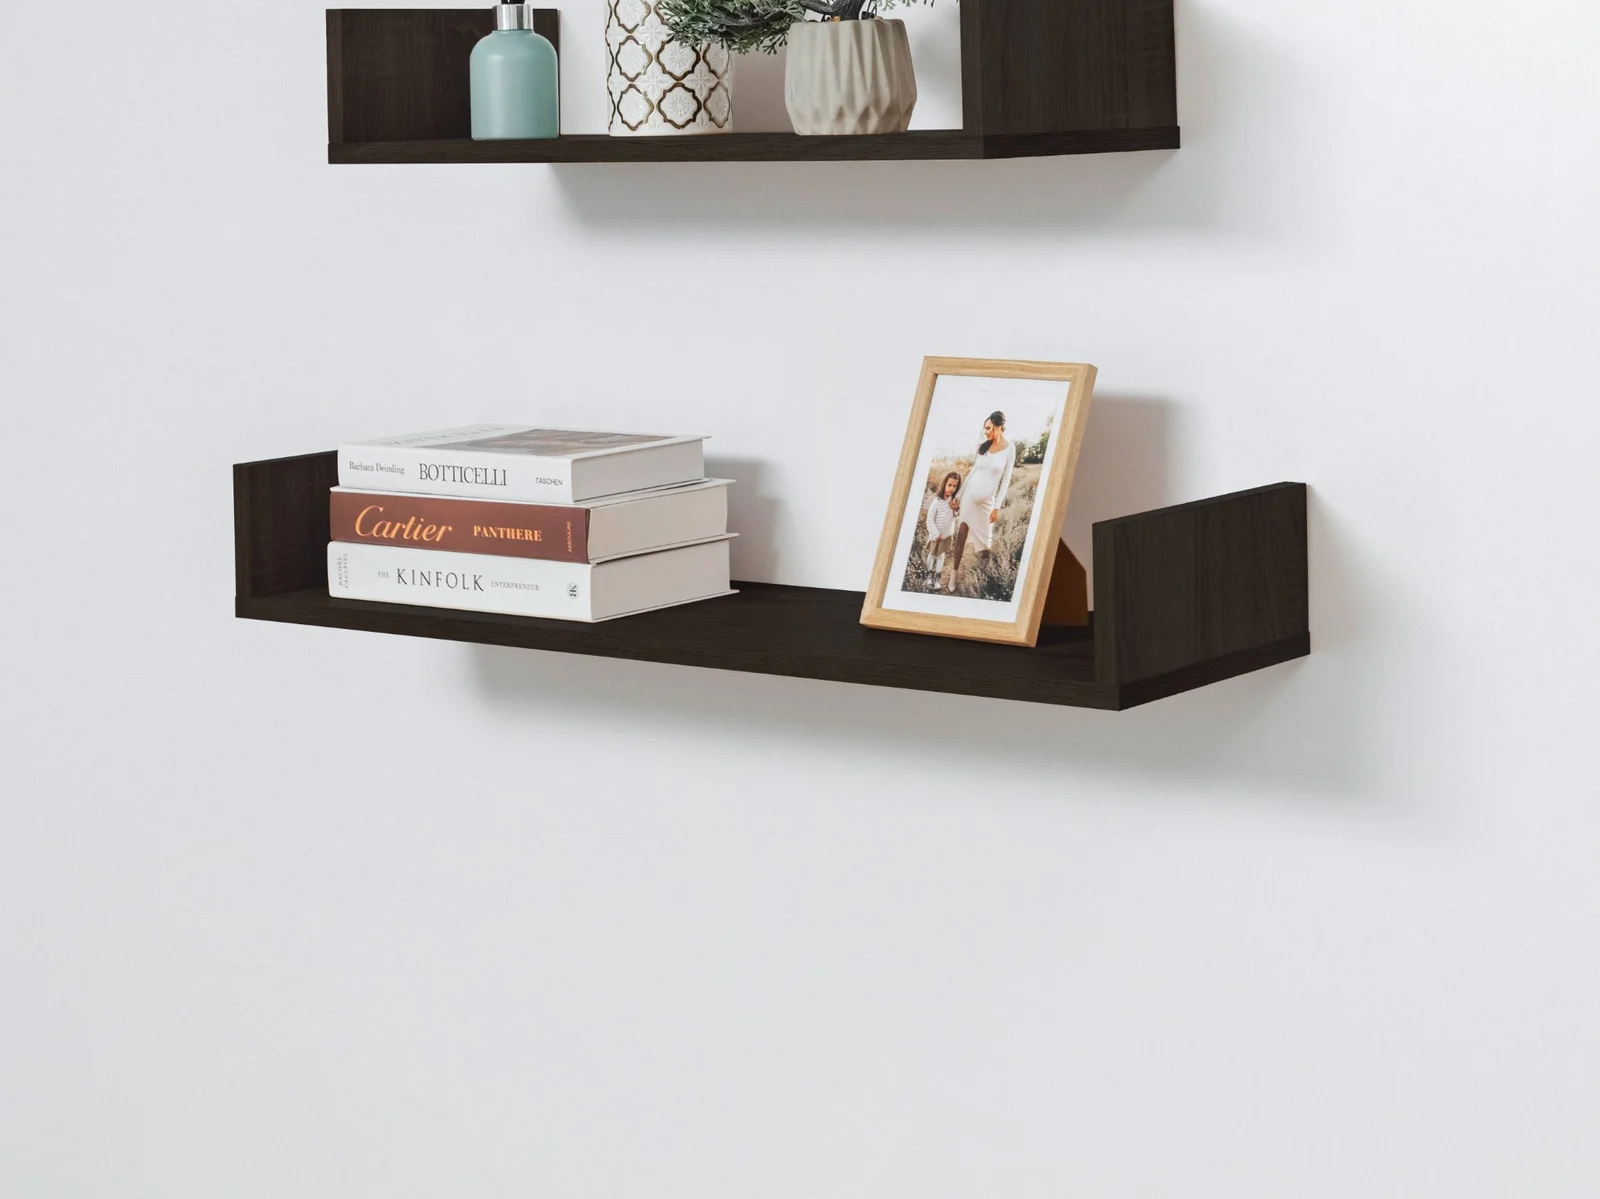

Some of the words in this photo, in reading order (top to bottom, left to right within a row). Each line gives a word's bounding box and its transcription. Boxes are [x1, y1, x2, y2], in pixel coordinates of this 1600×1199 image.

[349, 461, 374, 472] Barbara
[376, 463, 405, 476] Deimling
[419, 463, 508, 487] BOTTICELLI
[535, 477, 563, 486] TASCHEN
[355, 504, 453, 542] Cartier
[473, 524, 542, 542] PANTHERE
[396, 567, 485, 592] KINFOLK
